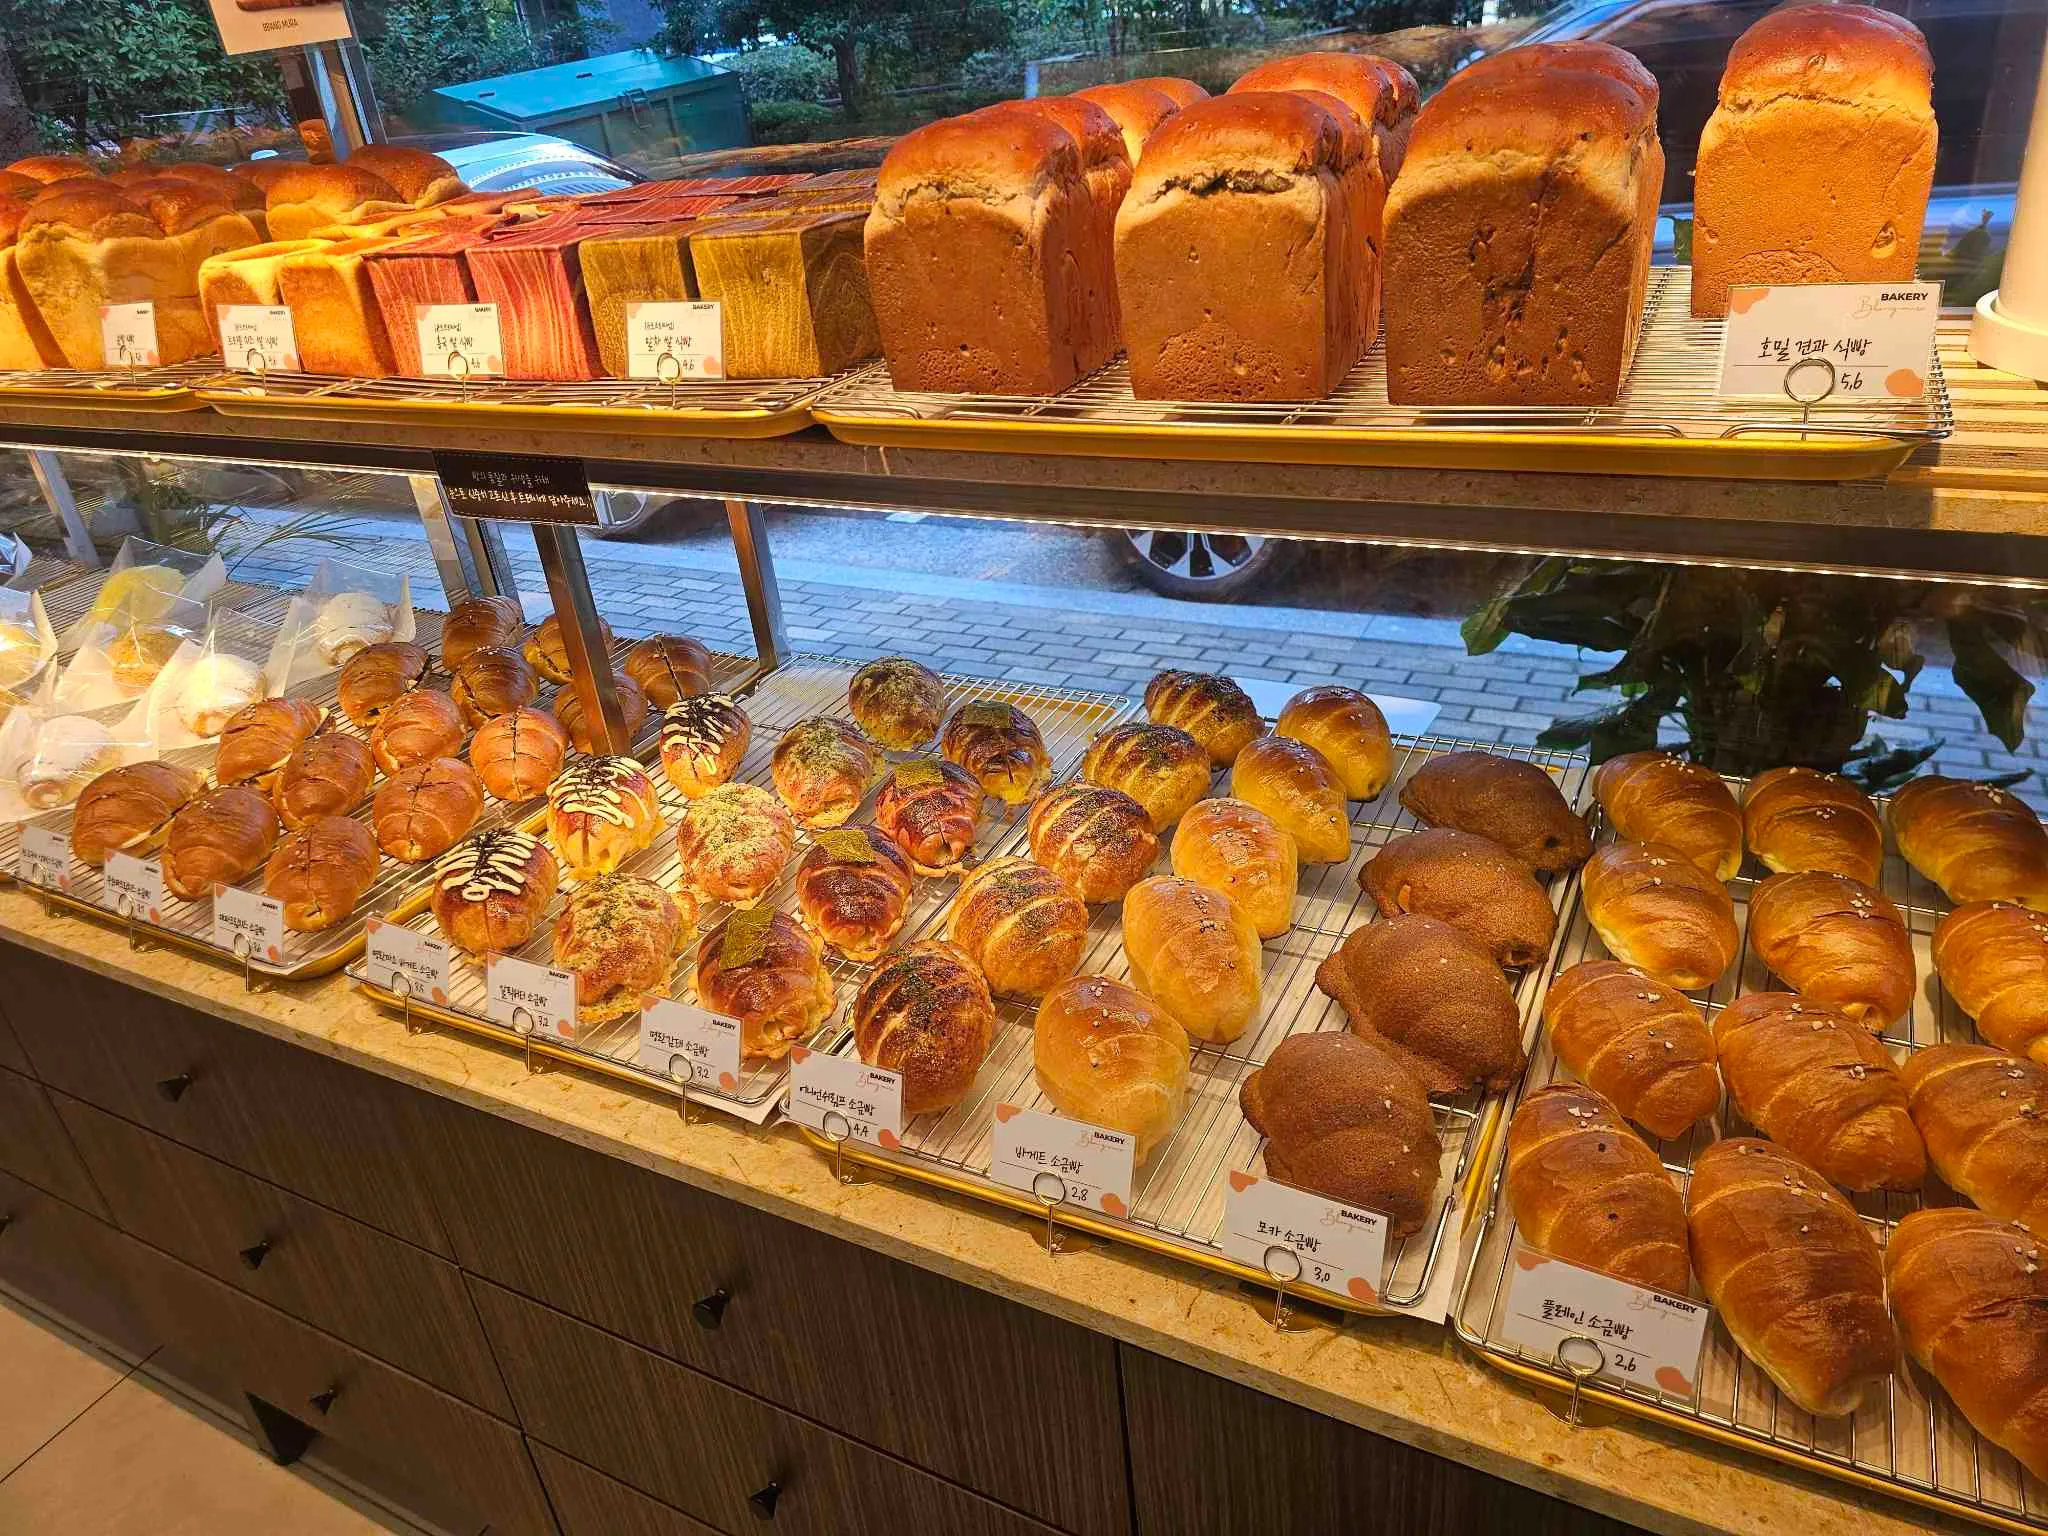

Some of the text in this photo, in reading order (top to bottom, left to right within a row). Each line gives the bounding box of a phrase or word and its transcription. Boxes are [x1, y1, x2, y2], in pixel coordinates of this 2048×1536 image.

[1881, 292, 1929, 301] BAKERY
[675, 335, 693, 351] 식빵
[1758, 337, 1873, 362] 호밀 견과 식빵
[527, 993, 549, 1008] 소금빵
[712, 1019, 736, 1031] BAKERY
[685, 1041, 710, 1058] 소금빵
[870, 1072, 897, 1085] BAKERY
[848, 1098, 878, 1117] 소금빵
[1094, 1131, 1125, 1145] BAKERY
[1015, 1146, 1084, 1174] 바게트 소금빵
[1341, 1209, 1377, 1226] BAKERY
[1257, 1220, 1322, 1253] 모카 소금빵
[1653, 1294, 1698, 1314] BAKERY
[1541, 1298, 1634, 1341] 플레인 소금빵
